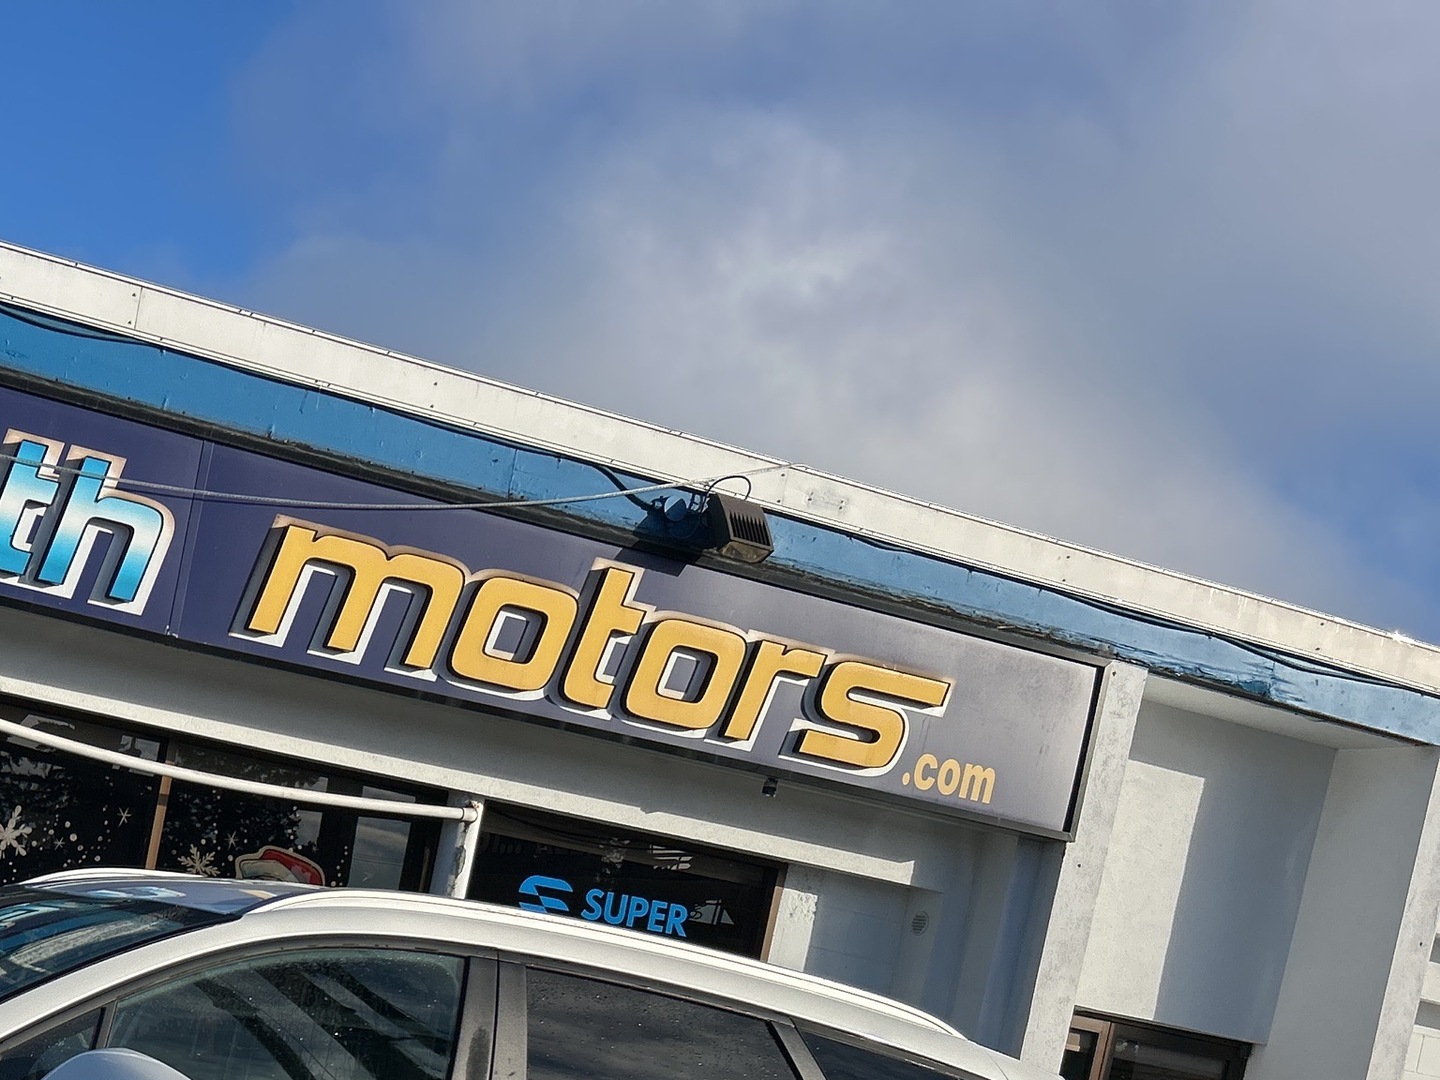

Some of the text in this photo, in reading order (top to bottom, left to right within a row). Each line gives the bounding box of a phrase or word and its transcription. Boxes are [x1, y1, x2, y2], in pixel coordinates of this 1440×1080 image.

[228, 512, 954, 777] motors
[902, 752, 995, 806] .com
[580, 887, 690, 938] SUPER
